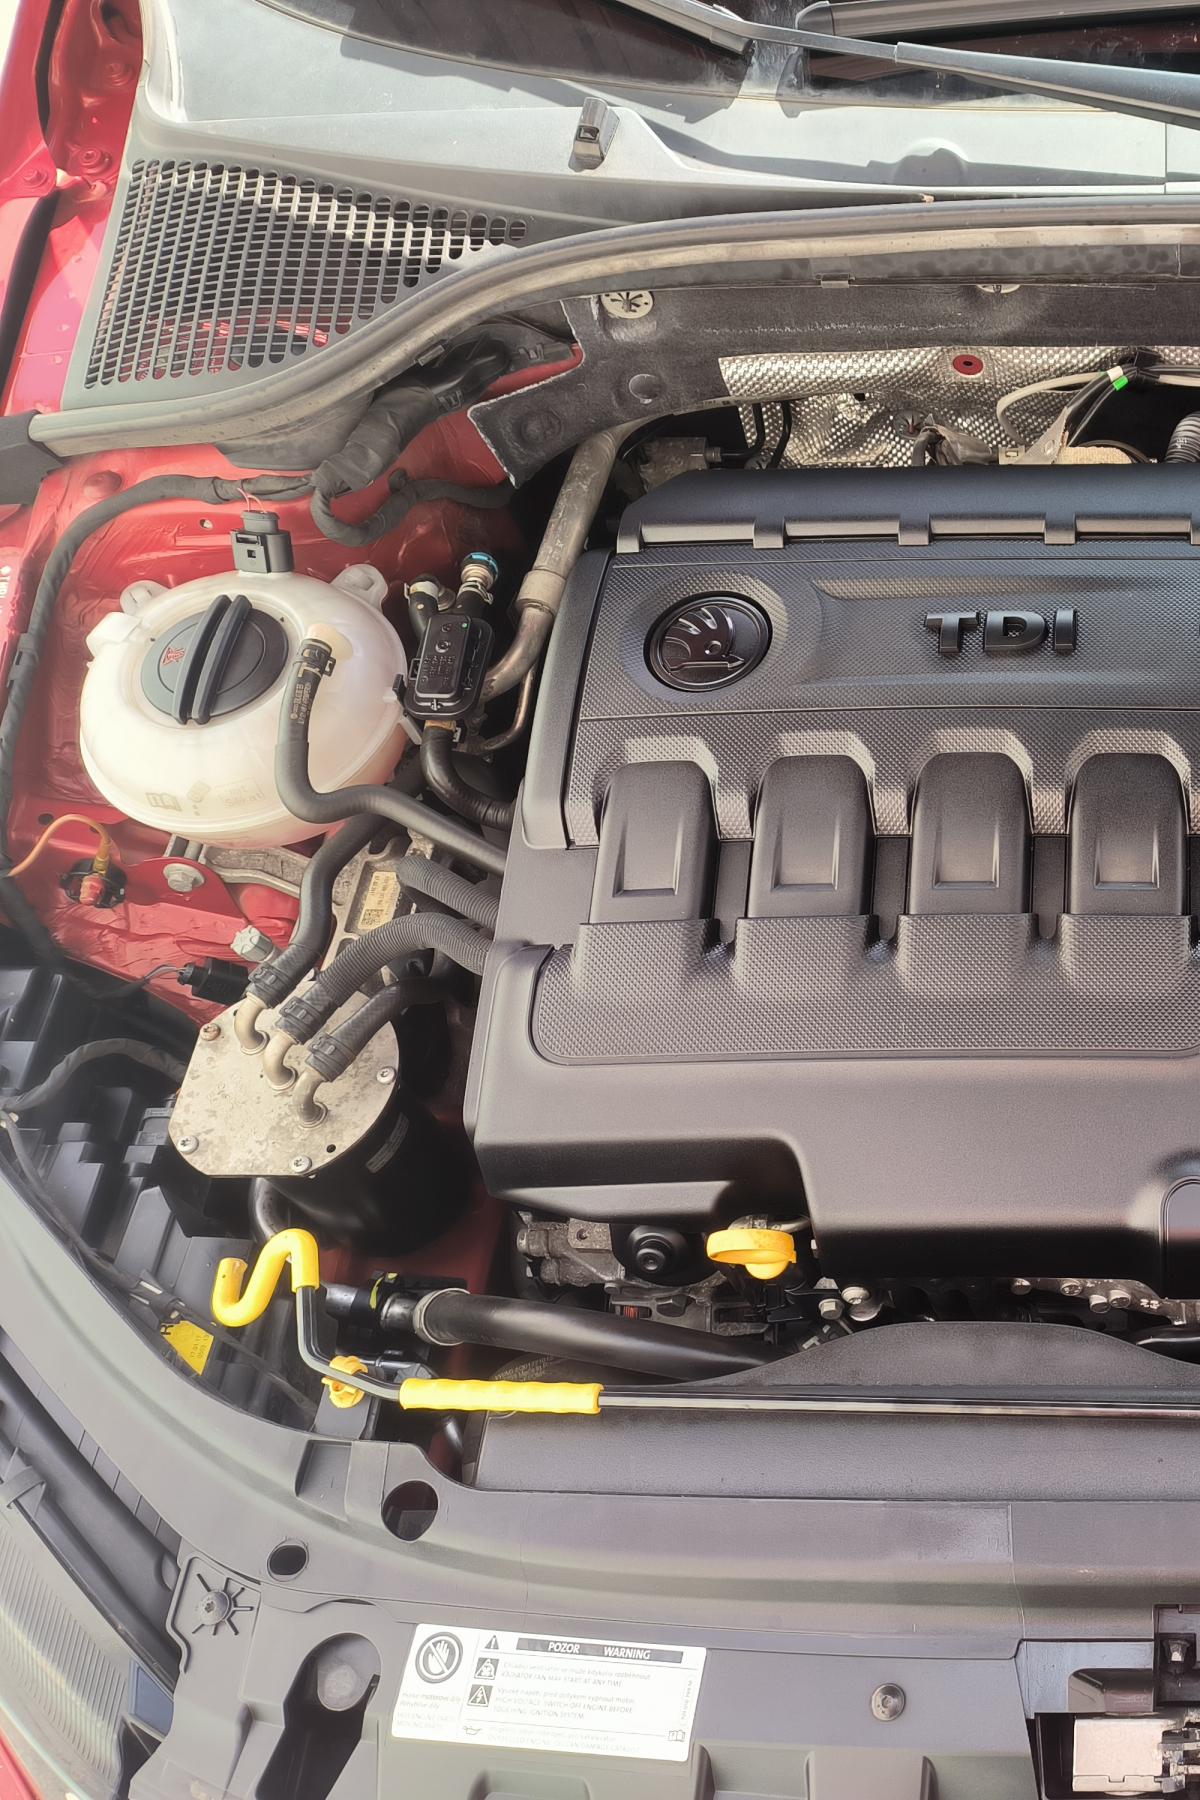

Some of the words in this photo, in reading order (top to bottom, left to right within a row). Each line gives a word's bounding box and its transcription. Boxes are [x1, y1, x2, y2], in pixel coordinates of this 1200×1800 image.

[924, 608, 1079, 654] TDI
[548, 1642, 580, 1654] POZOR
[604, 1646, 651, 1660] WARNING
